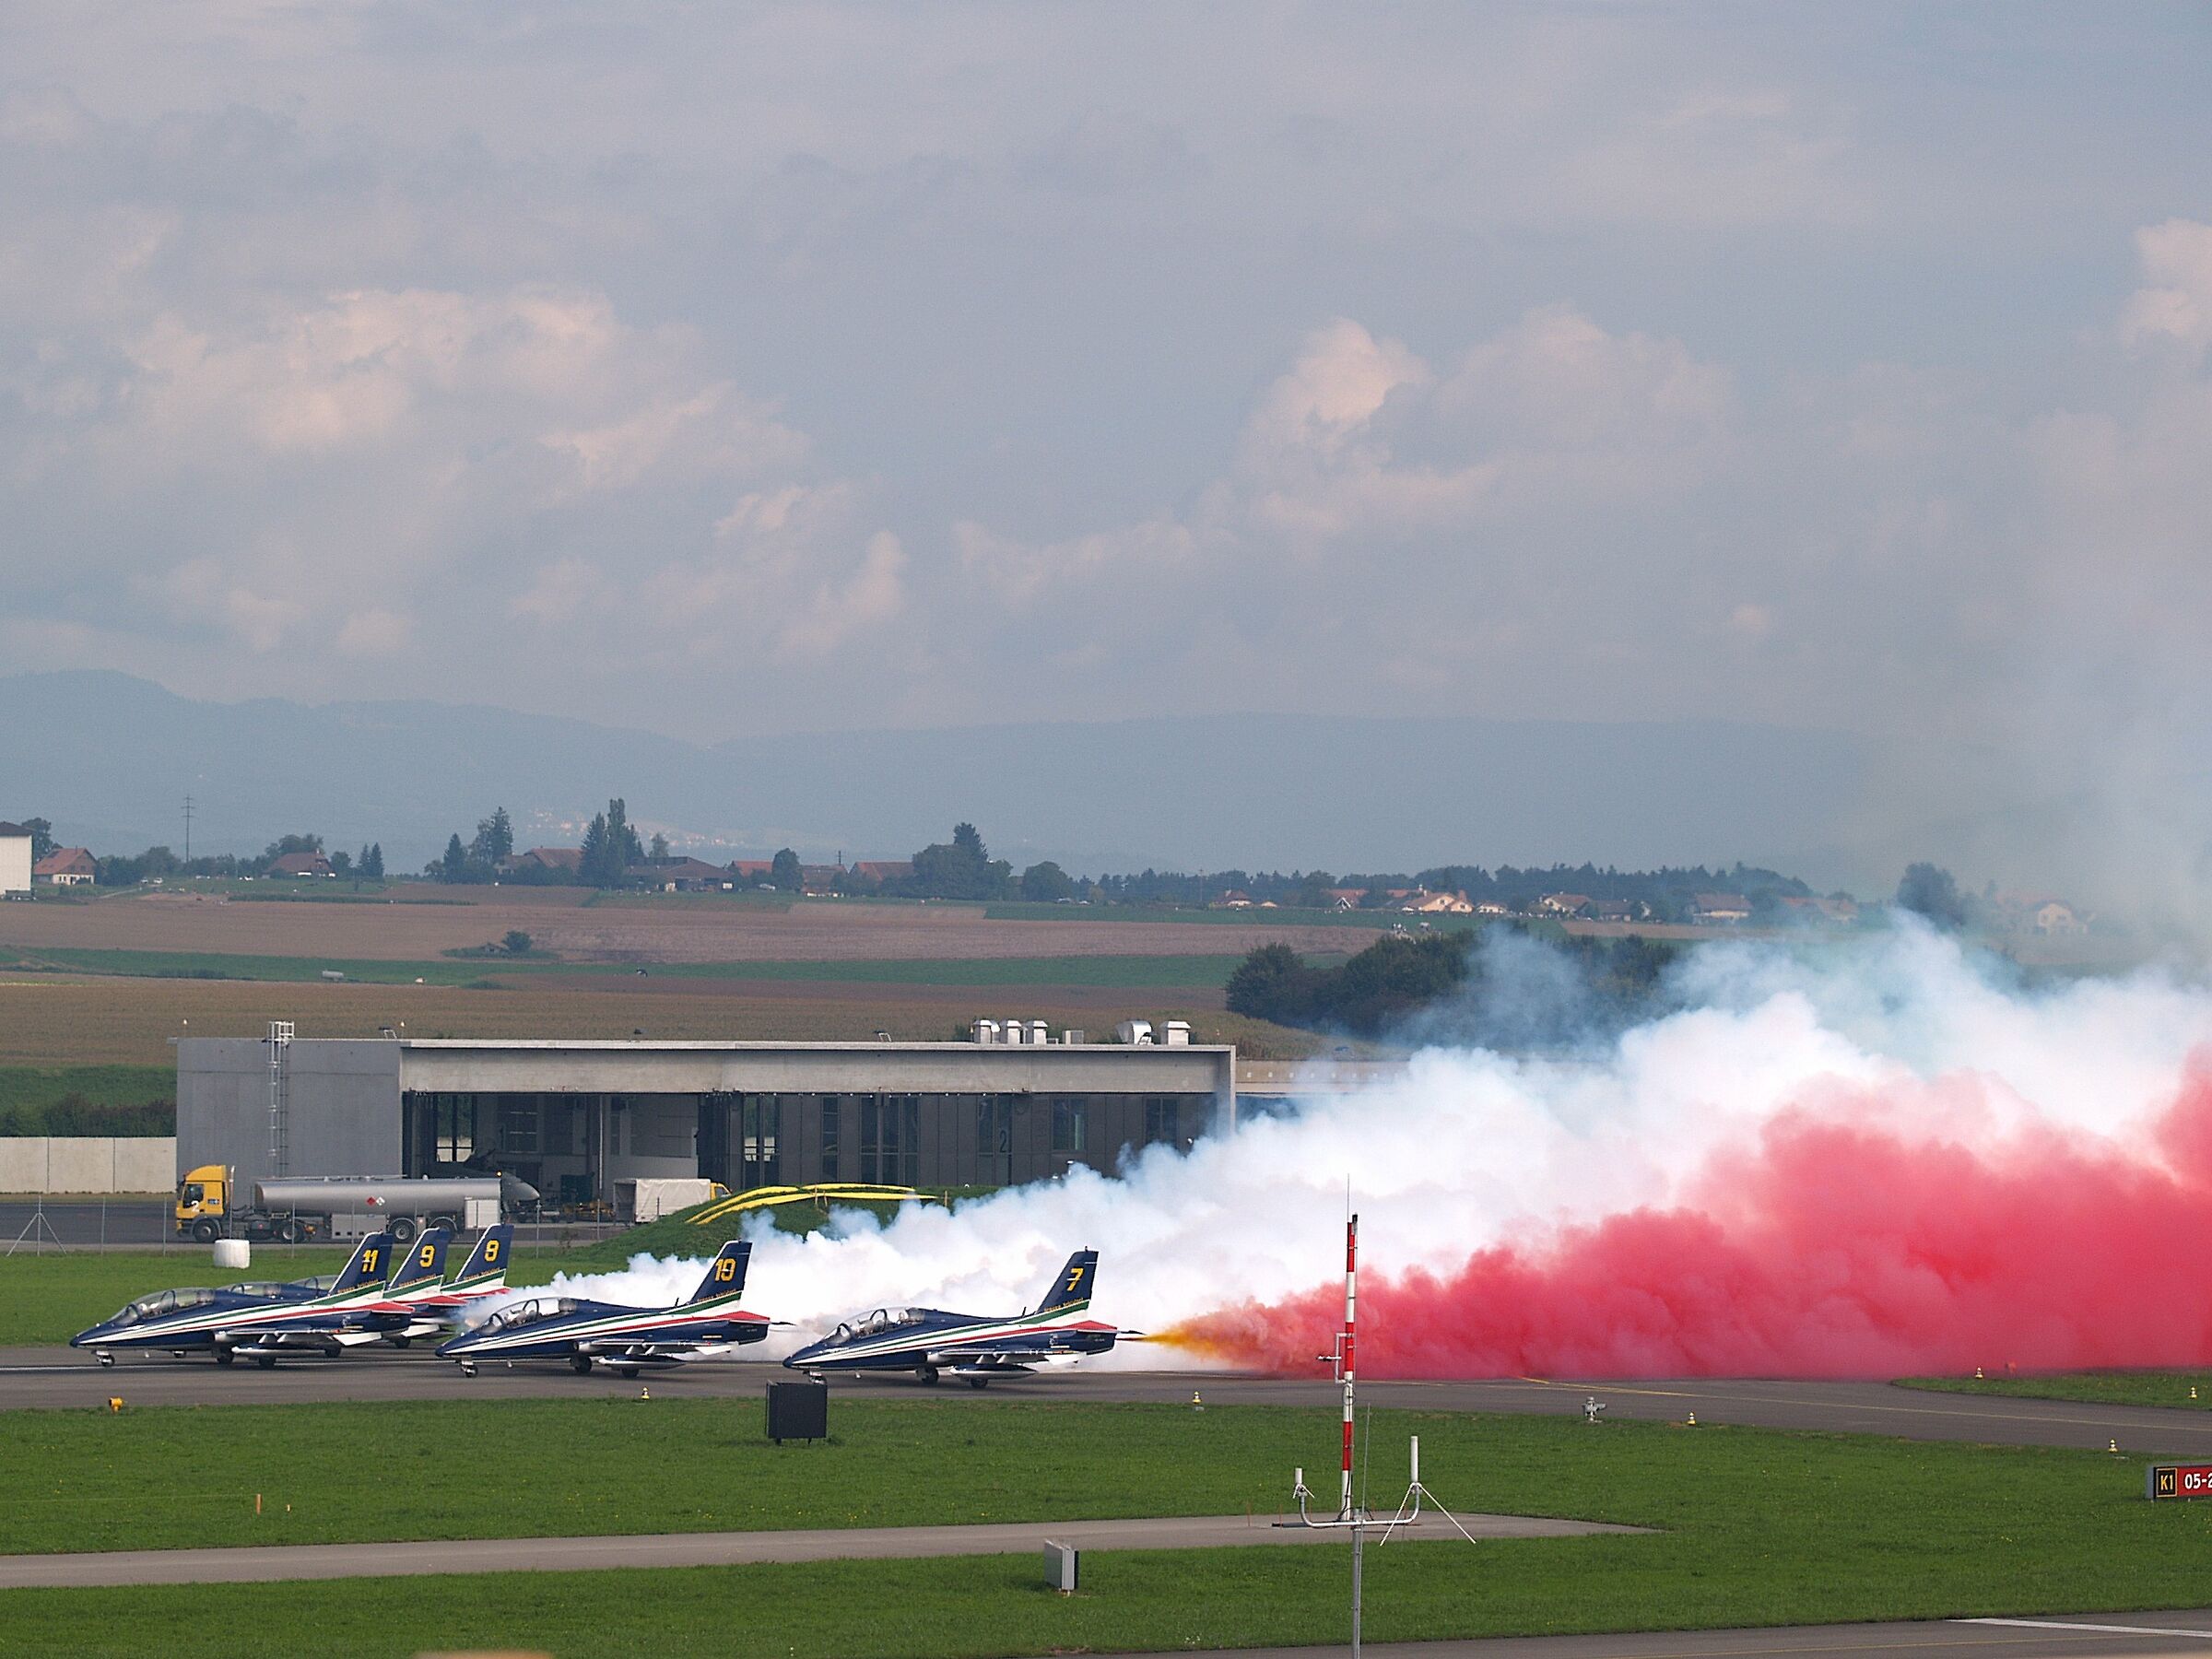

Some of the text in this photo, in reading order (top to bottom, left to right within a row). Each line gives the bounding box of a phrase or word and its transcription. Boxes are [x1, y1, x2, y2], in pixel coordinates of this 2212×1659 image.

[999, 1129, 1007, 1153] 2
[191, 1200, 200, 1213] 2
[362, 1249, 379, 1273] 11
[419, 1244, 435, 1268] 9
[1066, 1267, 1084, 1291] 7
[2160, 1475, 2173, 1490] K1
